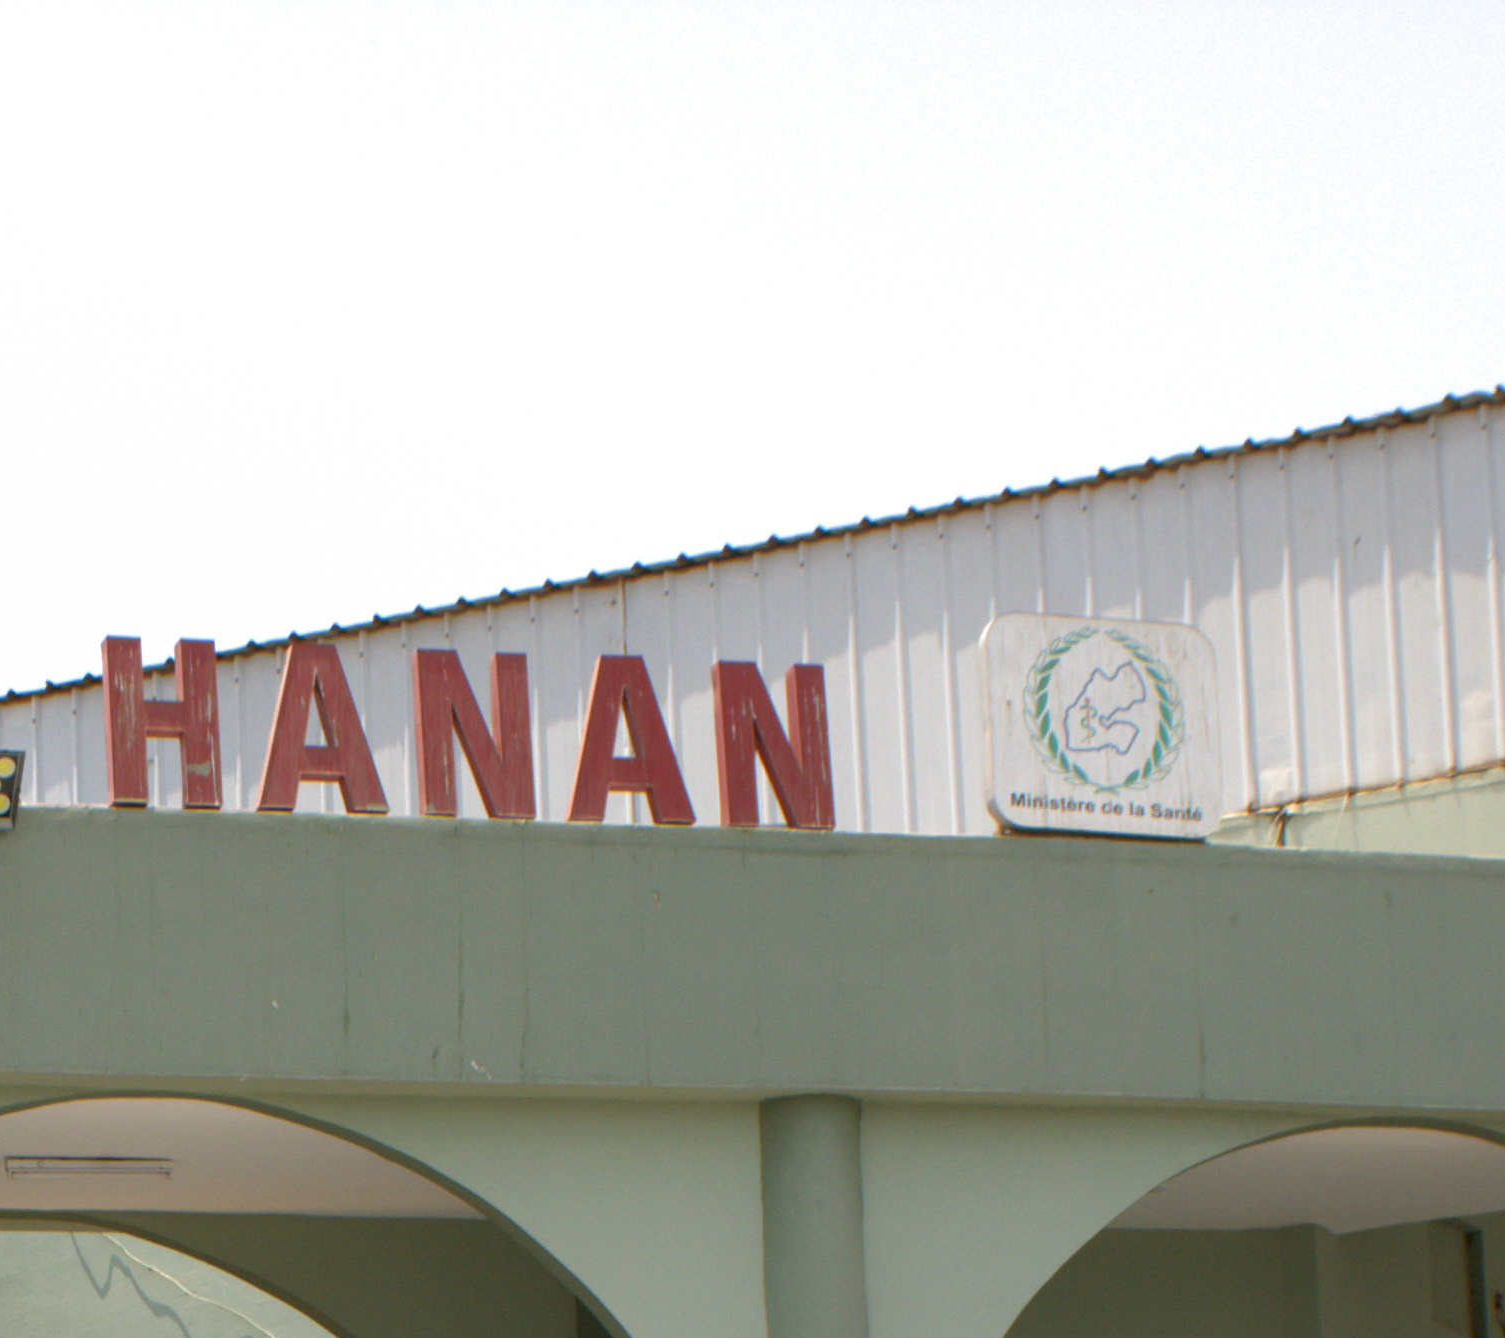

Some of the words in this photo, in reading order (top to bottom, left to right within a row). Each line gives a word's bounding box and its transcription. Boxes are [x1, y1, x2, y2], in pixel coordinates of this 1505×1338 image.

[101, 636, 837, 832] HANAN
[1010, 792, 1095, 814] Ministère
[1101, 800, 1123, 816] de
[1128, 802, 1146, 817] la
[1150, 803, 1203, 822] Santé
